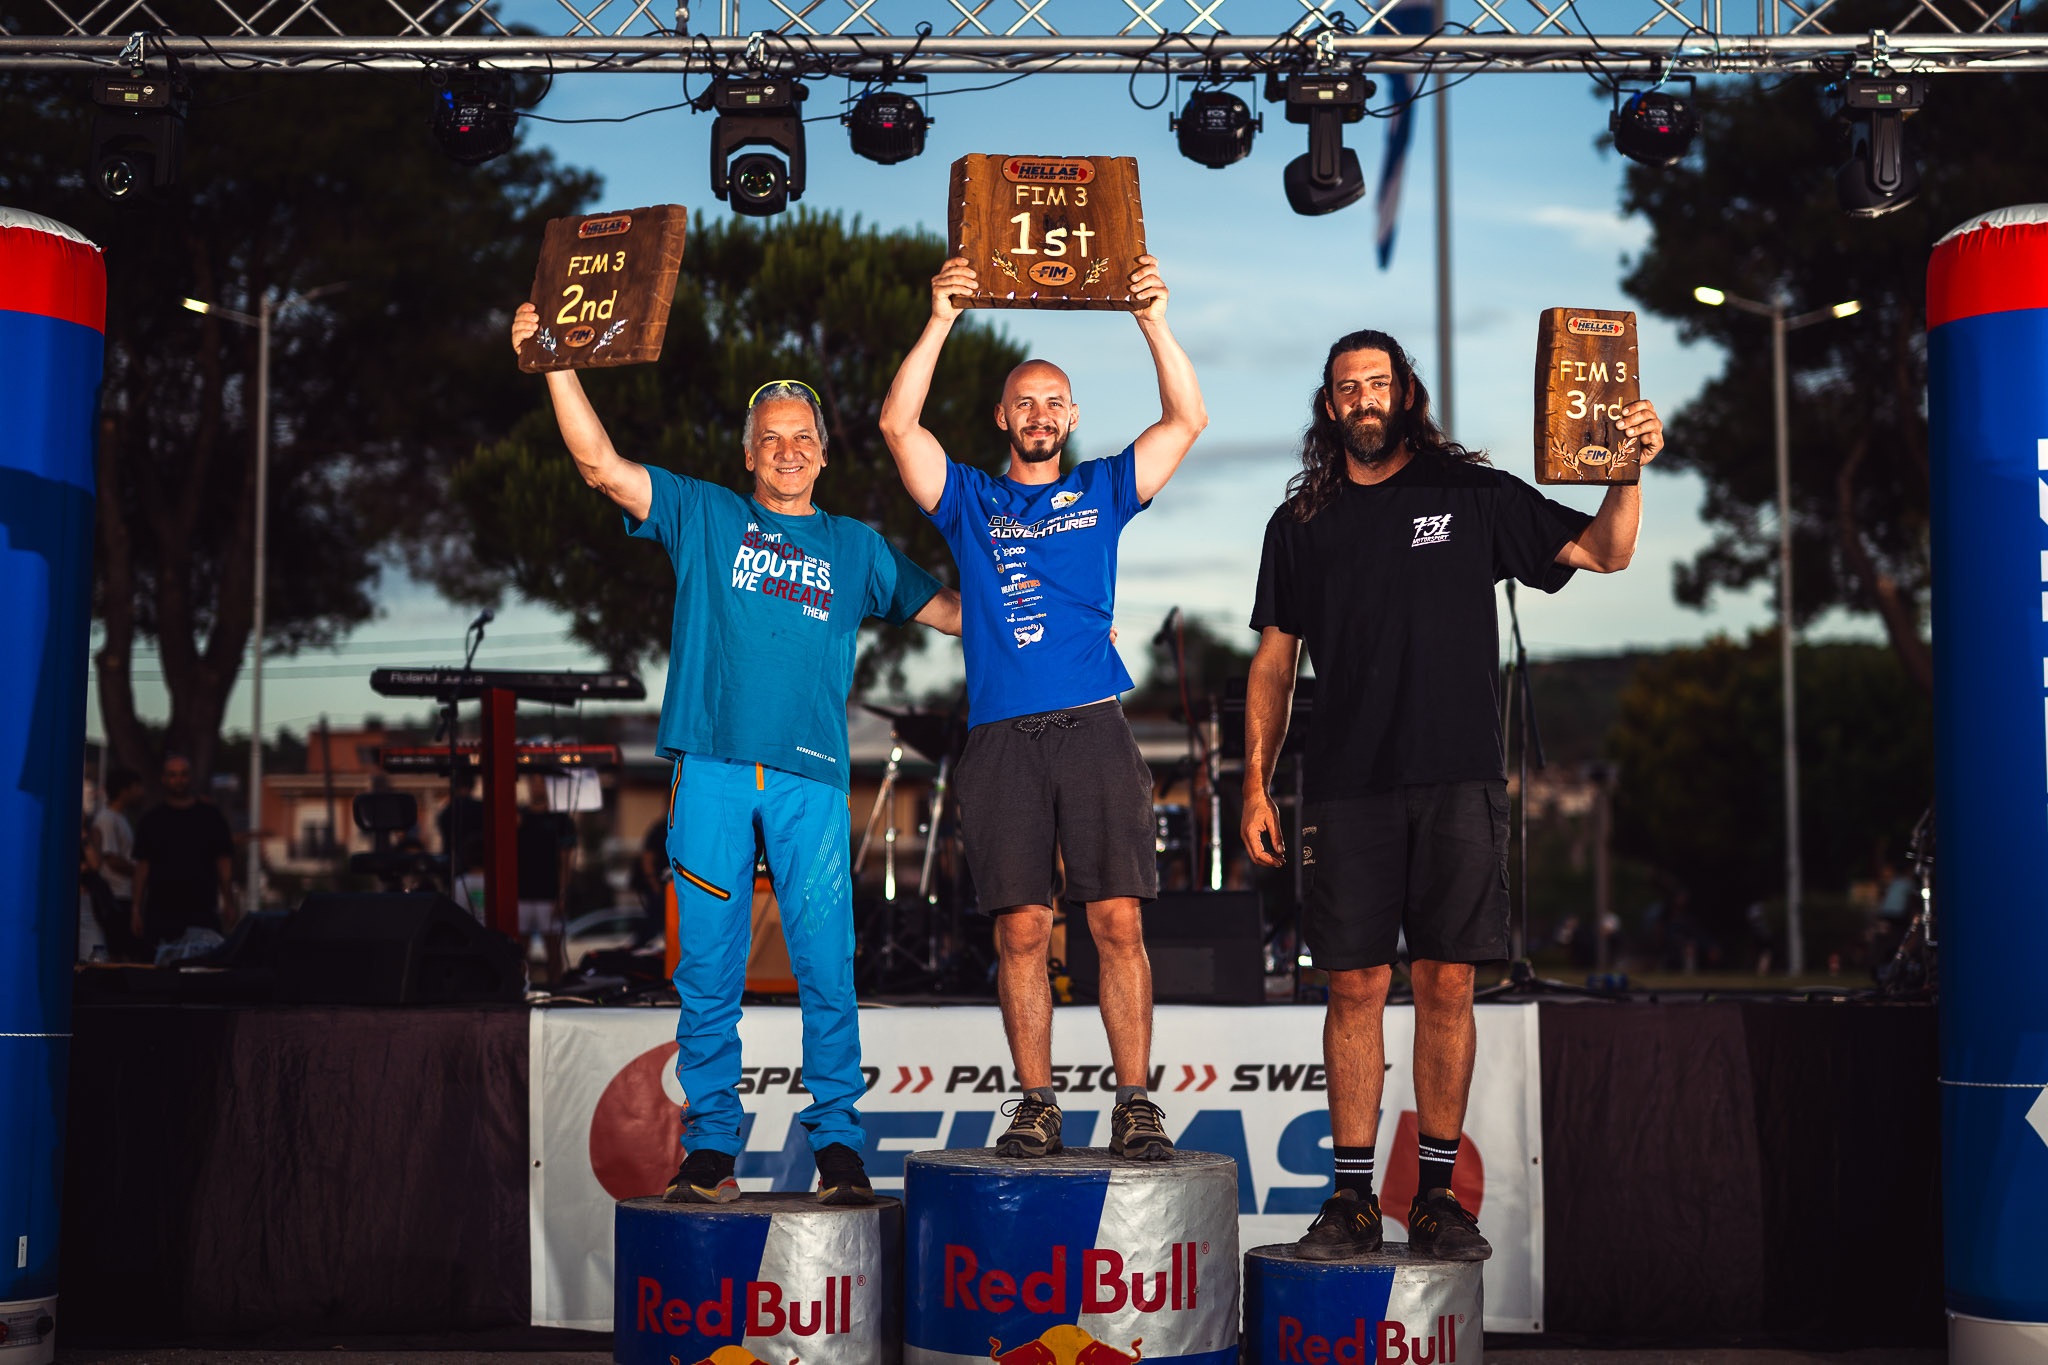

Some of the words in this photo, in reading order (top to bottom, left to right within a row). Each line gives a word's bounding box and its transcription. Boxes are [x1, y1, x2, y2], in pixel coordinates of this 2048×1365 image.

[1018, 166, 1079, 176] HELLAS
[1016, 185, 1068, 206] FIM
[1074, 187, 1088, 207] 3
[1010, 212, 1096, 258] 1st
[568, 253, 609, 277] FIM
[612, 251, 626, 272] 3
[1038, 266, 1069, 278] FIM
[556, 284, 618, 325] 2nd
[570, 329, 592, 342] FIM
[1577, 322, 1614, 331] HELLAS
[1560, 361, 1609, 383] FIM
[1615, 362, 1628, 382] 3
[1566, 390, 1624, 421] 3rd
[1584, 450, 1608, 461] FIM
[989, 515, 1098, 539] ADVENTURES
[1047, 512, 1076, 525] RALLY
[1077, 508, 1099, 517] TEAM
[762, 533, 783, 543] ON'T
[741, 531, 805, 561] SEARCH
[805, 555, 818, 565] FOR
[819, 558, 831, 571] THE
[733, 545, 834, 595] ROUTES,
[731, 568, 762, 592] WE
[762, 577, 834, 612] CREATE
[802, 604, 830, 622] THEM!
[391, 671, 438, 684] Roland
[1229, 1063, 1393, 1092] SWE
[944, 1243, 1067, 1314] Red
[1081, 1241, 1198, 1314] Bull
[637, 1275, 733, 1337] Red
[745, 1275, 852, 1337] Bull
[1278, 1315, 1366, 1365] Red
[1375, 1314, 1456, 1365] Bull
